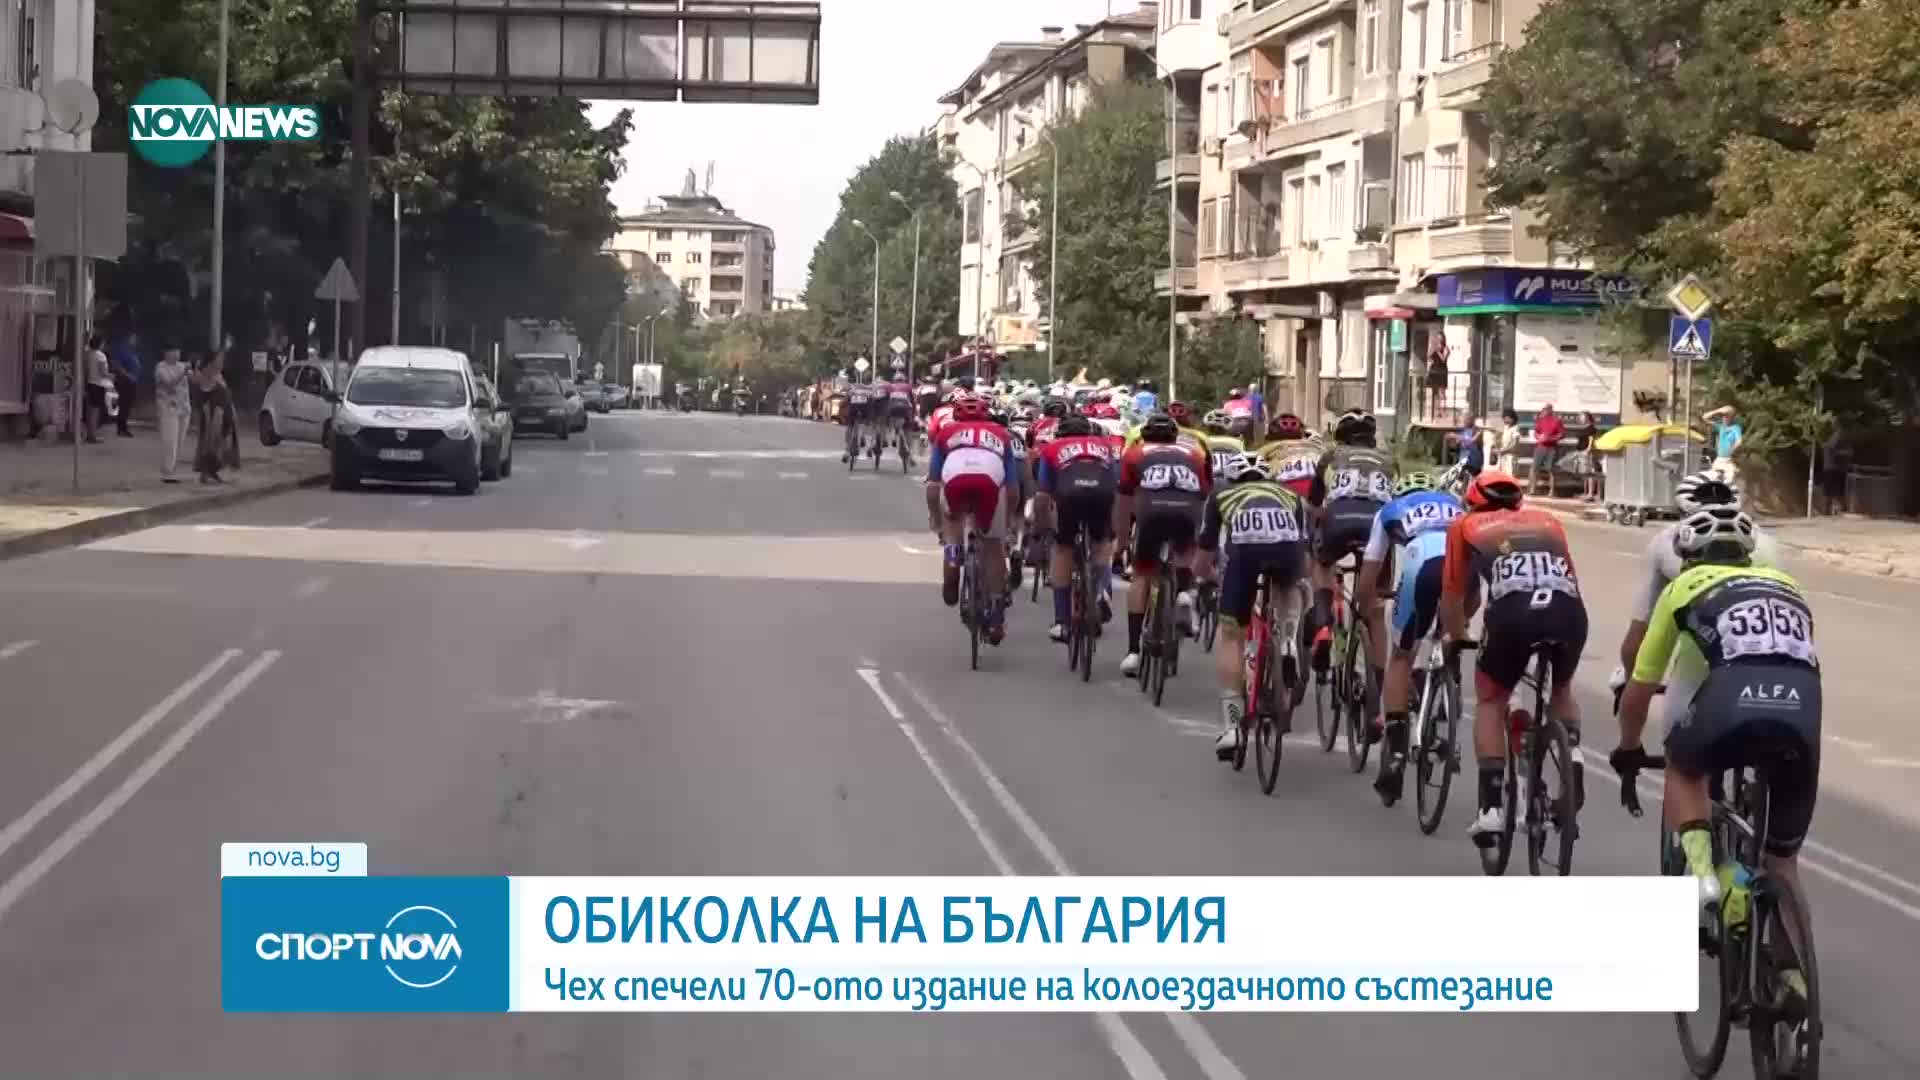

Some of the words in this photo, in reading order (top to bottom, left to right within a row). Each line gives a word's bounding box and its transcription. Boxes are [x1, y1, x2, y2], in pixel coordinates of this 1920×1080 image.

[1233, 510, 1263, 532] 106
[1406, 504, 1435, 524] 142
[1495, 555, 1528, 582] 152
[1728, 604, 1769, 636] 53
[1774, 604, 1806, 641] 53
[1740, 683, 1800, 700] ALFA
